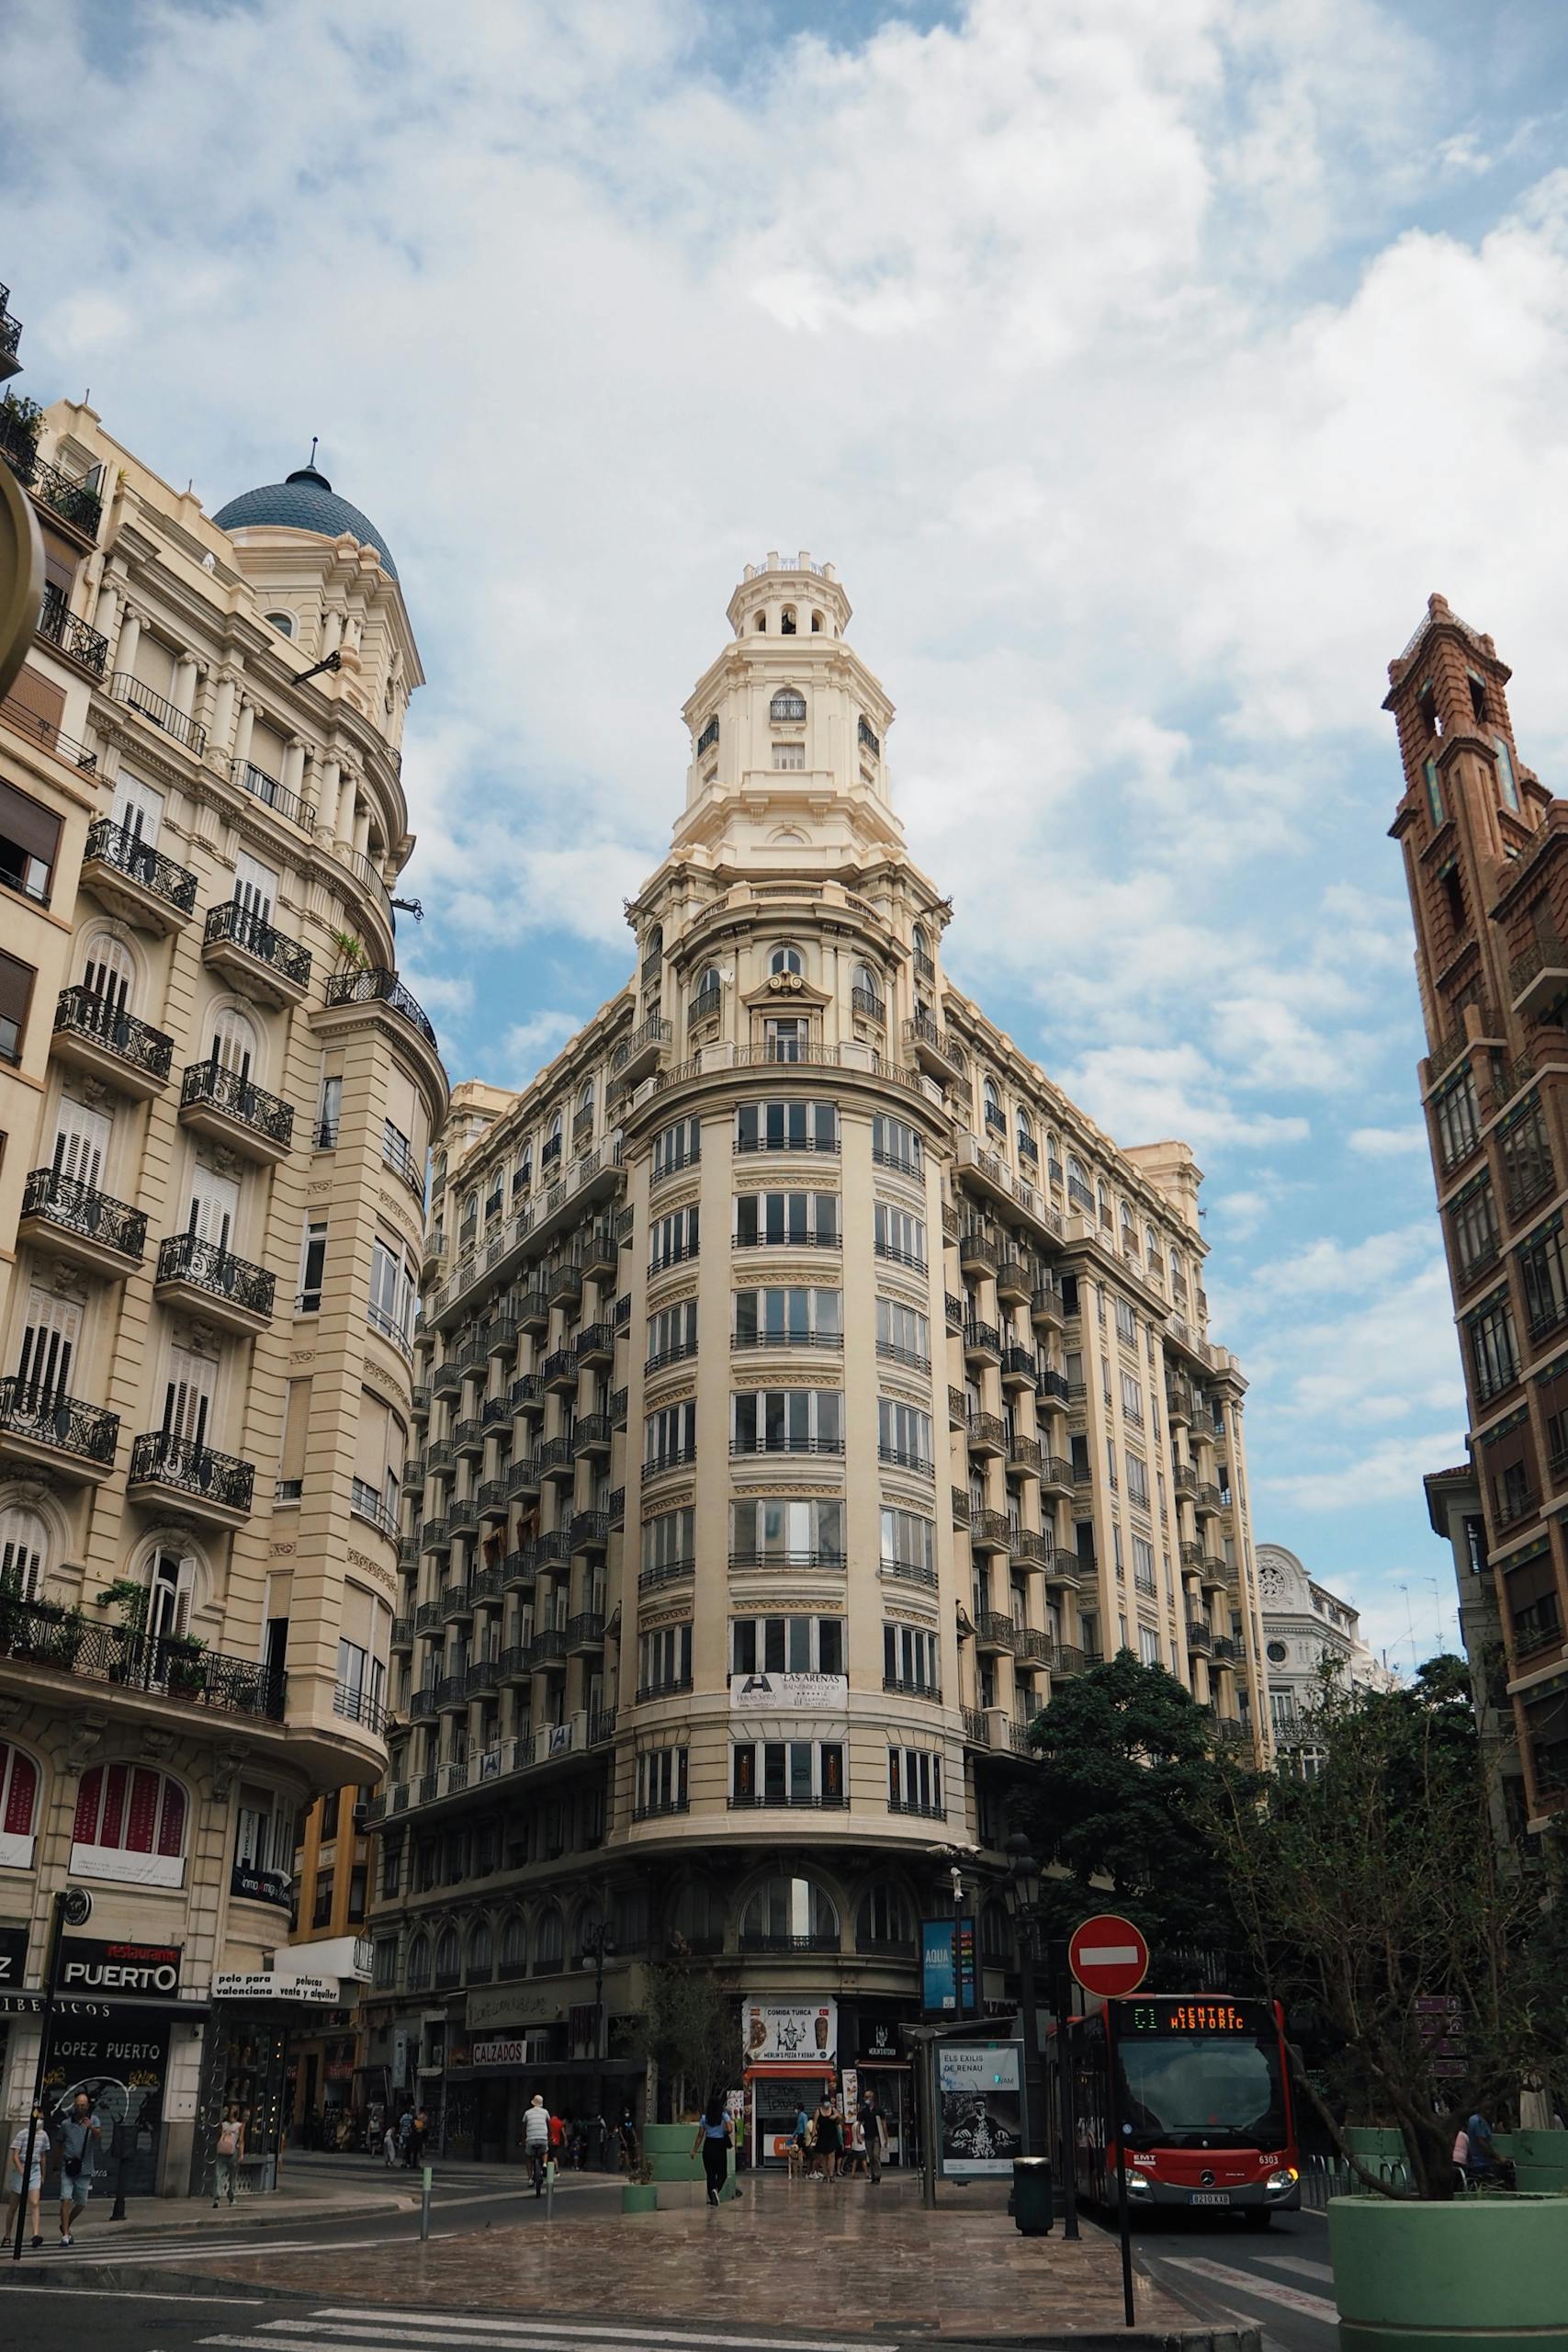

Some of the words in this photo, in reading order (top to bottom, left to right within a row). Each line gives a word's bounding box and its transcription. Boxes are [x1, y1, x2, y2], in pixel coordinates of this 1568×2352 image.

[784, 1674, 800, 1682] LAS
[803, 1674, 840, 1684] ARENAS
[107, 1943, 177, 1962] restaurante
[925, 1949, 949, 1963] AQUA
[63, 1962, 177, 1991] PUERTO
[219, 1974, 242, 1984] pelo
[245, 1975, 271, 1984] para
[296, 1975, 322, 1987] pelucas
[216, 1985, 273, 1996] valenciana
[280, 1986, 300, 1996] venta
[303, 1989, 308, 1997] y
[310, 1989, 337, 2001] alquiler
[1134, 2009, 1157, 2029] C1
[1177, 2007, 1236, 2018] CENTRE
[1170, 2018, 1245, 2030] HISTORIC
[53, 2041, 98, 2057] LOPEZ
[106, 2042, 160, 2060] PUERTO
[474, 2043, 523, 2063] CALZADOS
[1258, 2154, 1279, 2165] 6303
